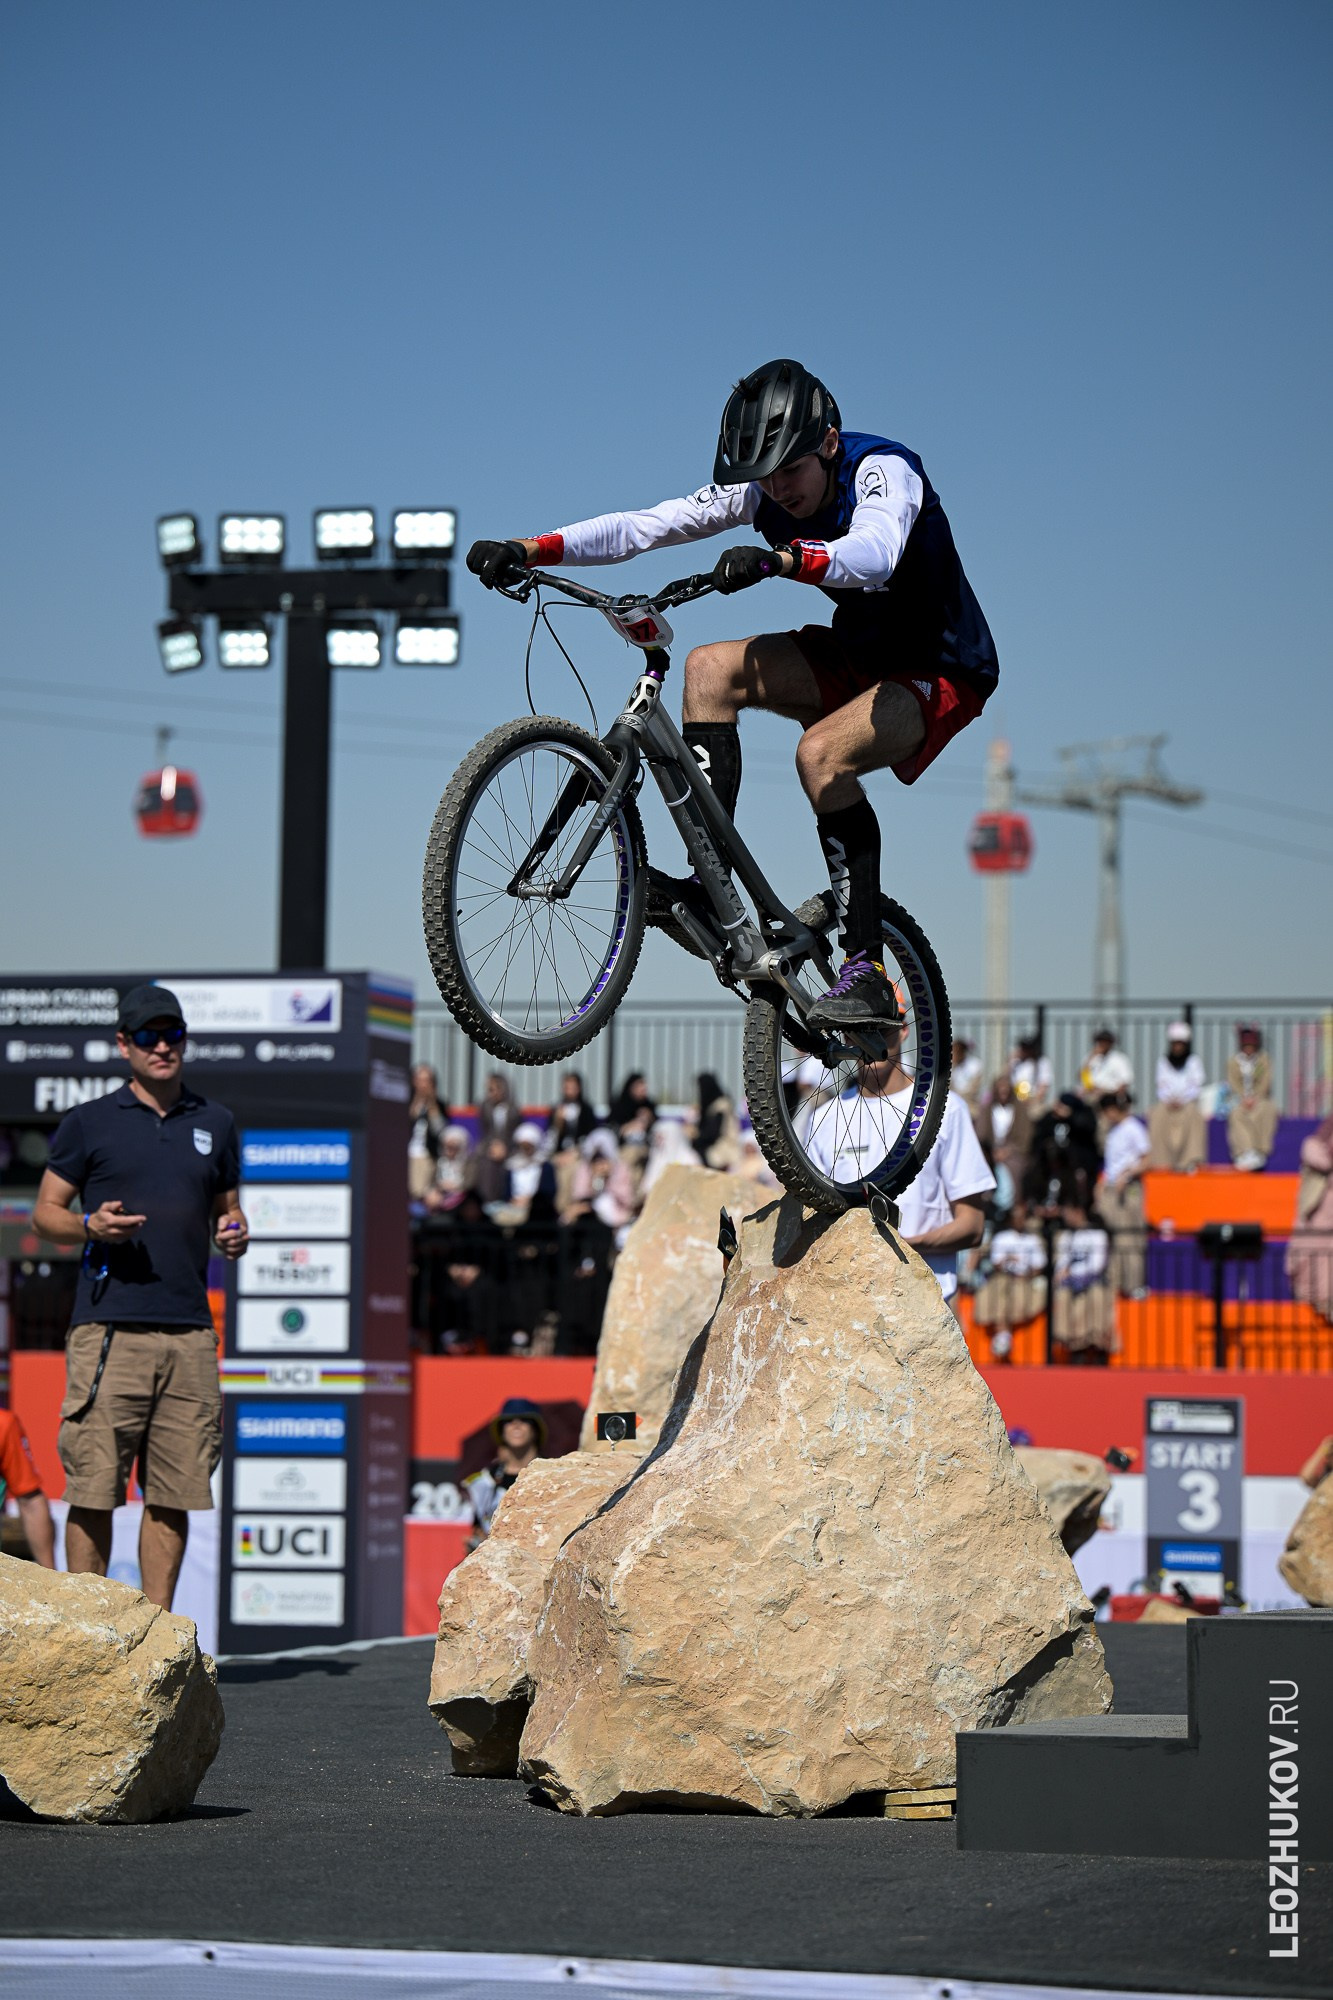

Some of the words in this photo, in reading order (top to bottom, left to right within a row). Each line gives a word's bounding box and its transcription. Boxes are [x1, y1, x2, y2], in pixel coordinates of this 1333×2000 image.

[243, 1144, 349, 1166] SHIMANO
[256, 1265, 332, 1283] TISSOT
[268, 1366, 315, 1386] UCI
[238, 1417, 345, 1438] SHIMANO
[1151, 1442, 1235, 1469] START
[1177, 1470, 1222, 1533] 3
[258, 1526, 329, 1557] UCI
